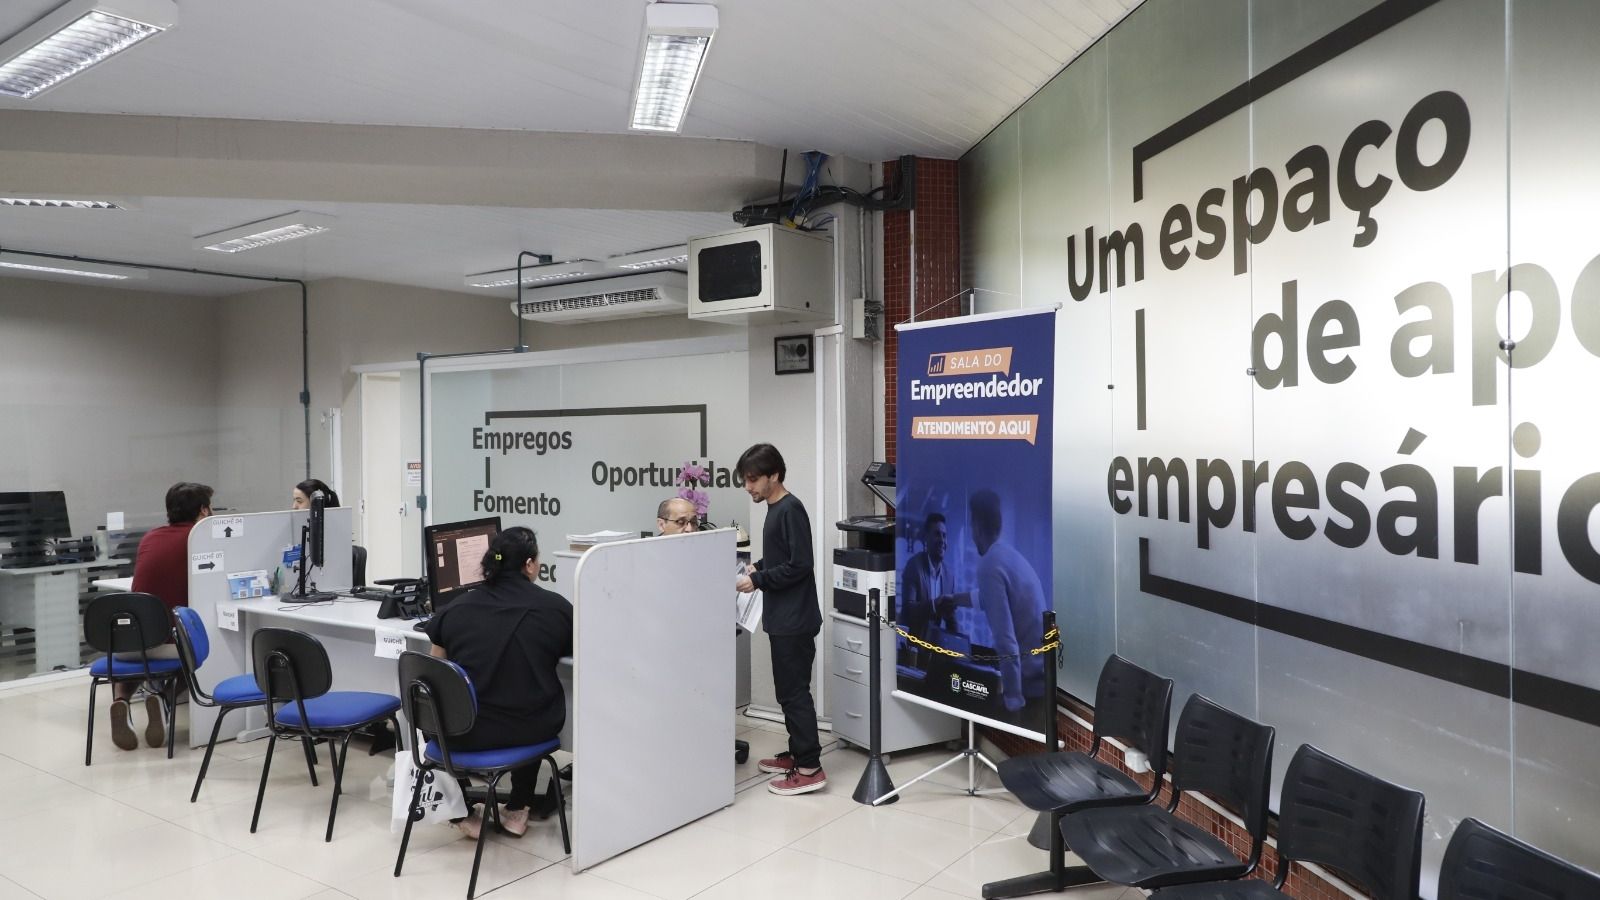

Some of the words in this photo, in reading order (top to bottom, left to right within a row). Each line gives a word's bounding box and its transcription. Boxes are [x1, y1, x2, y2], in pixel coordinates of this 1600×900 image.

[1067, 222, 1144, 302] Um
[1159, 90, 1471, 276] espaço
[1251, 279, 1361, 390] de
[950, 355, 980, 369] SALA
[984, 353, 1002, 367] DO
[911, 372, 1043, 406] Empreendedor
[472, 427, 572, 455] Empregos
[916, 421, 996, 435] ATENDIMENTO
[998, 419, 1031, 435] AQUI
[473, 489, 561, 517] Fomento
[962, 681, 989, 694] CASCAVEL
